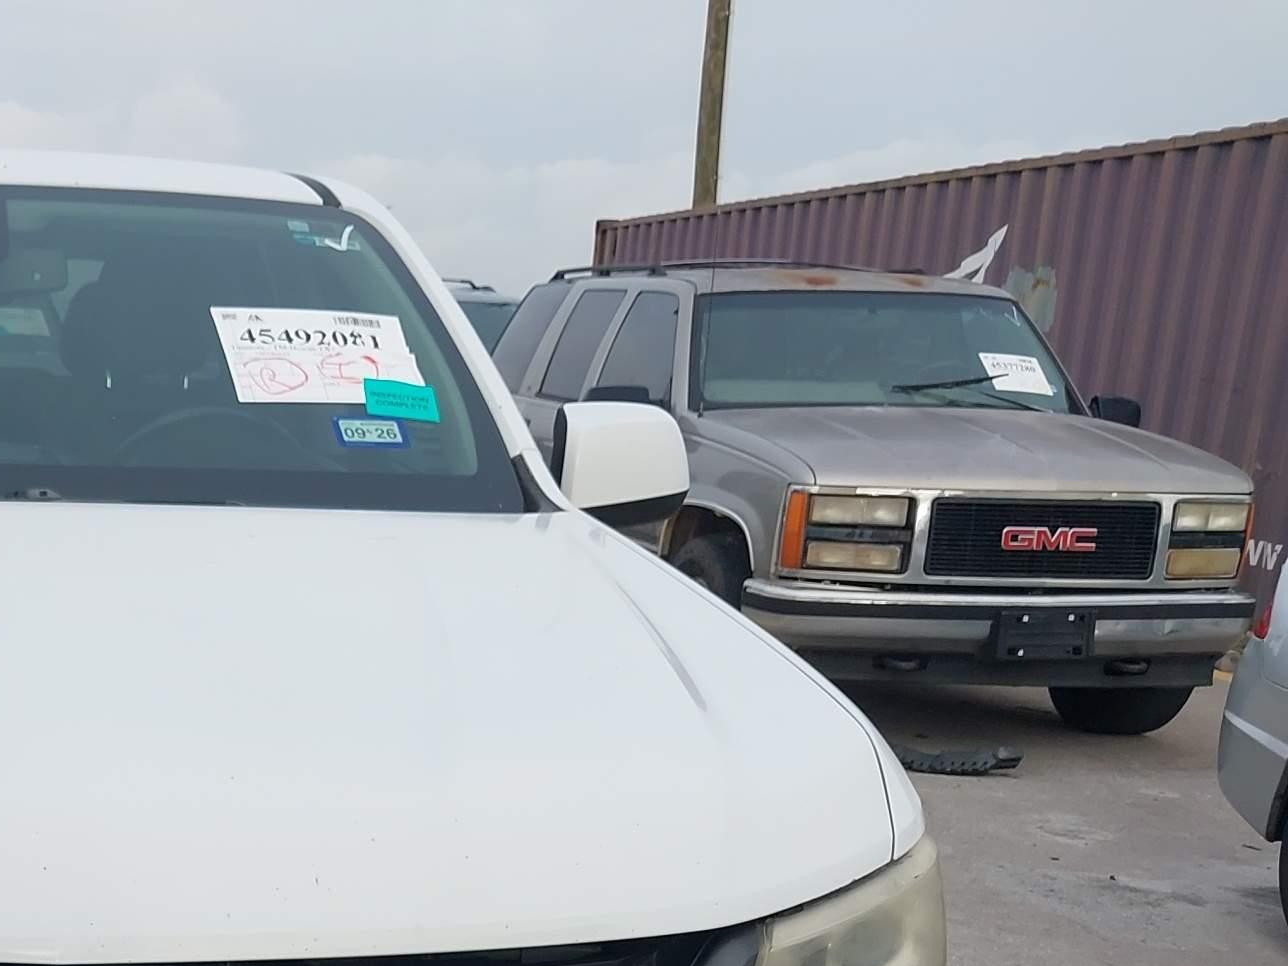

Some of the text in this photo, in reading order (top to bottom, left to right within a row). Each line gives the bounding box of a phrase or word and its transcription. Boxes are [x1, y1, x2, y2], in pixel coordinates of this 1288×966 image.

[239, 328, 381, 350] 45492081
[343, 427, 398, 441] 09 26
[1001, 526, 1098, 552] GMC
